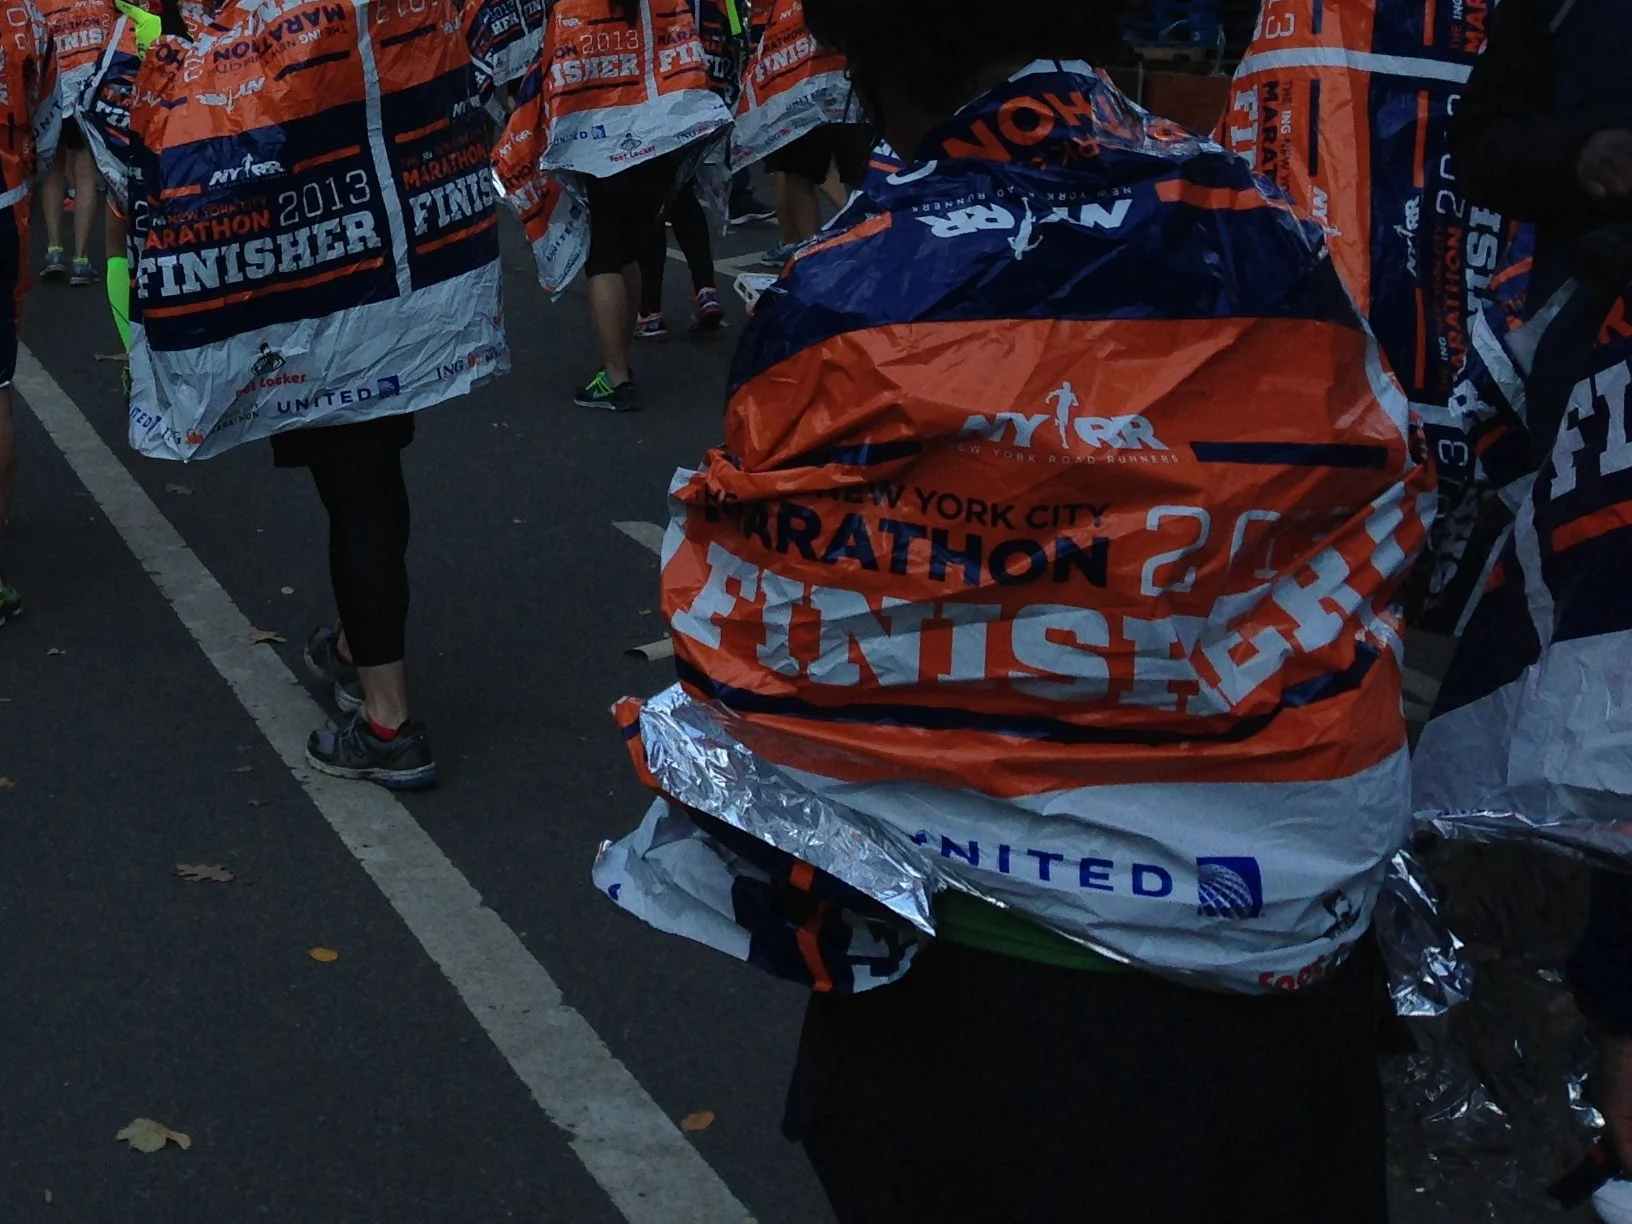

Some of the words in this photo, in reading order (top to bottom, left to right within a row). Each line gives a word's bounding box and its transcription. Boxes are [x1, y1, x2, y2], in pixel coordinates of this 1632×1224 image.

[298, 30, 321, 45] ING
[580, 29, 640, 55] 2013
[1280, 110, 1292, 134] ING
[209, 157, 286, 186] NYRR
[279, 169, 371, 227] 2013
[137, 211, 382, 299] FINISHER
[277, 388, 372, 414] UNITED
[960, 398, 1171, 450] NYRR
[993, 448, 1036, 463] YORK
[1049, 454, 1096, 465] ROAD
[1107, 455, 1179, 465] RUNNERS
[915, 487, 1014, 530] YORK
[1026, 498, 1110, 532] CITY
